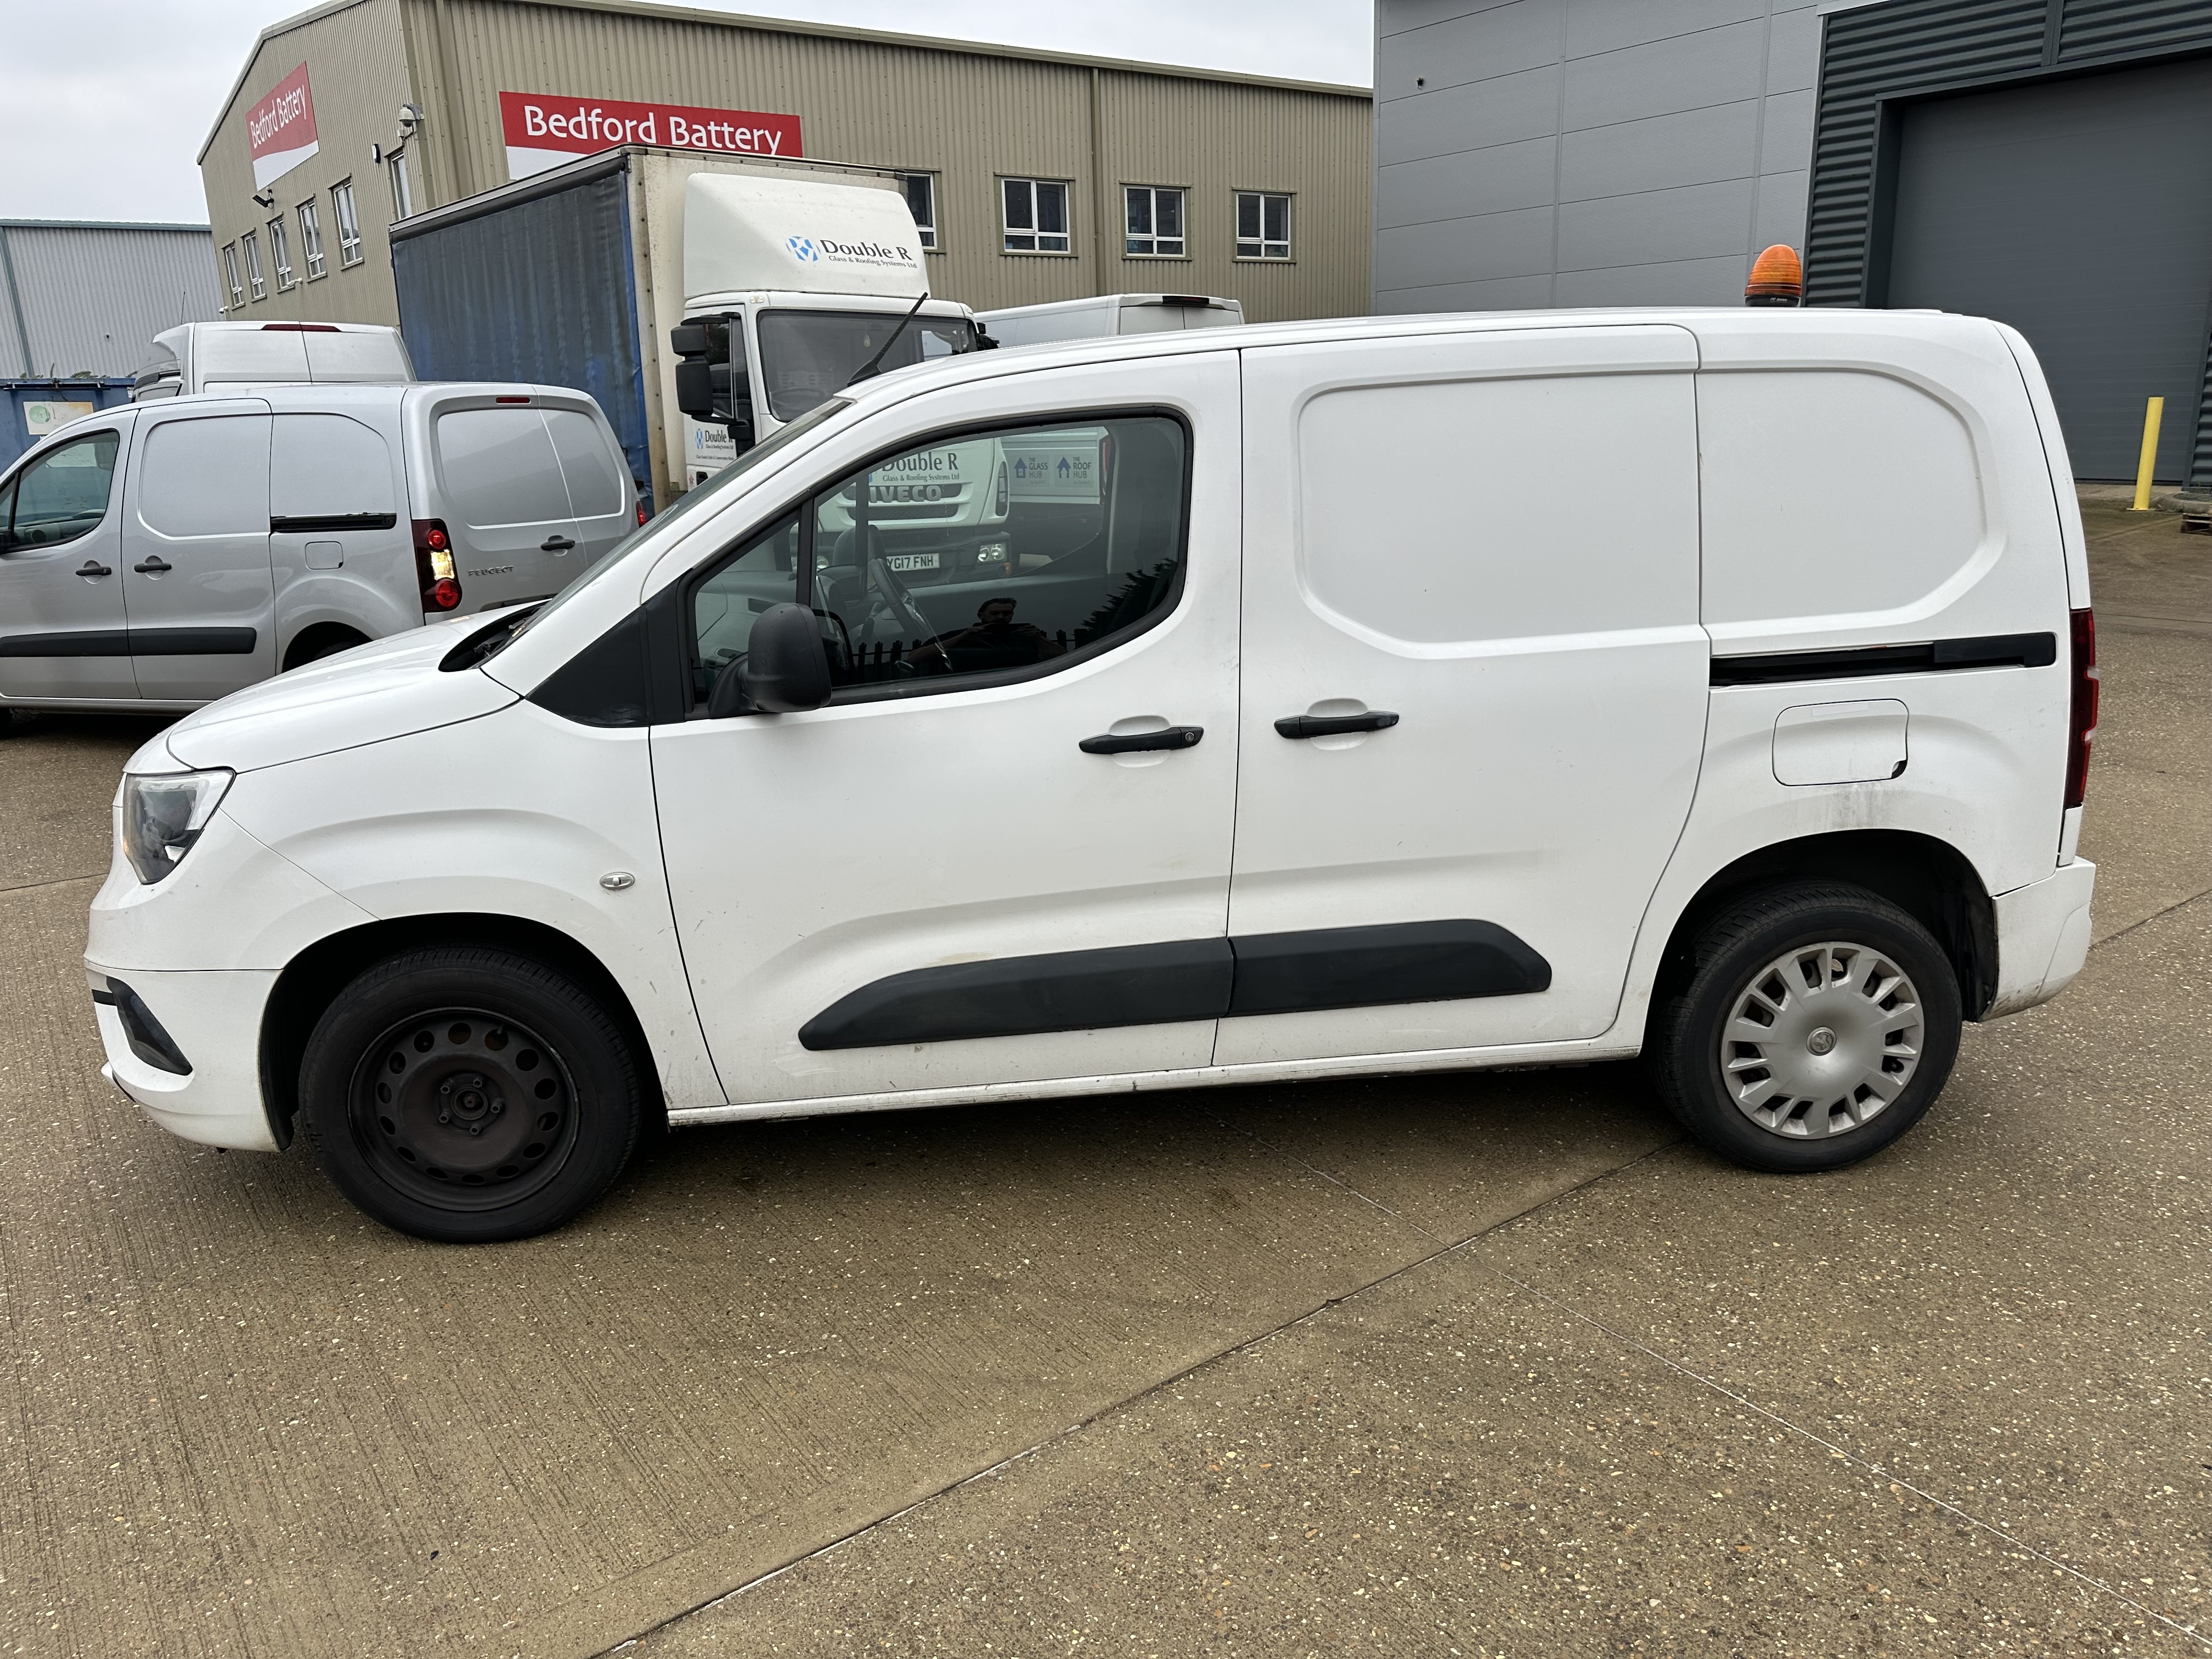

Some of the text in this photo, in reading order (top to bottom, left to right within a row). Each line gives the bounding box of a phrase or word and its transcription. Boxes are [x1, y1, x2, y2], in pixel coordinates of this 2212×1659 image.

[250, 84, 307, 149] Bedford Battery
[524, 105, 782, 156] Bedford Battery
[820, 239, 913, 261] Double R
[855, 257, 881, 267] Roofing
[705, 430, 727, 443] Double
[947, 453, 959, 471] R
[1073, 462, 1091, 470] ROOF
[906, 473, 928, 483] Roofing
[928, 474, 950, 482] Systems
[1073, 470, 1087, 478] HUB
[870, 485, 942, 503] IVECO
[887, 555, 933, 569] YG17 FNH
[468, 565, 514, 577] PEUGEOT
